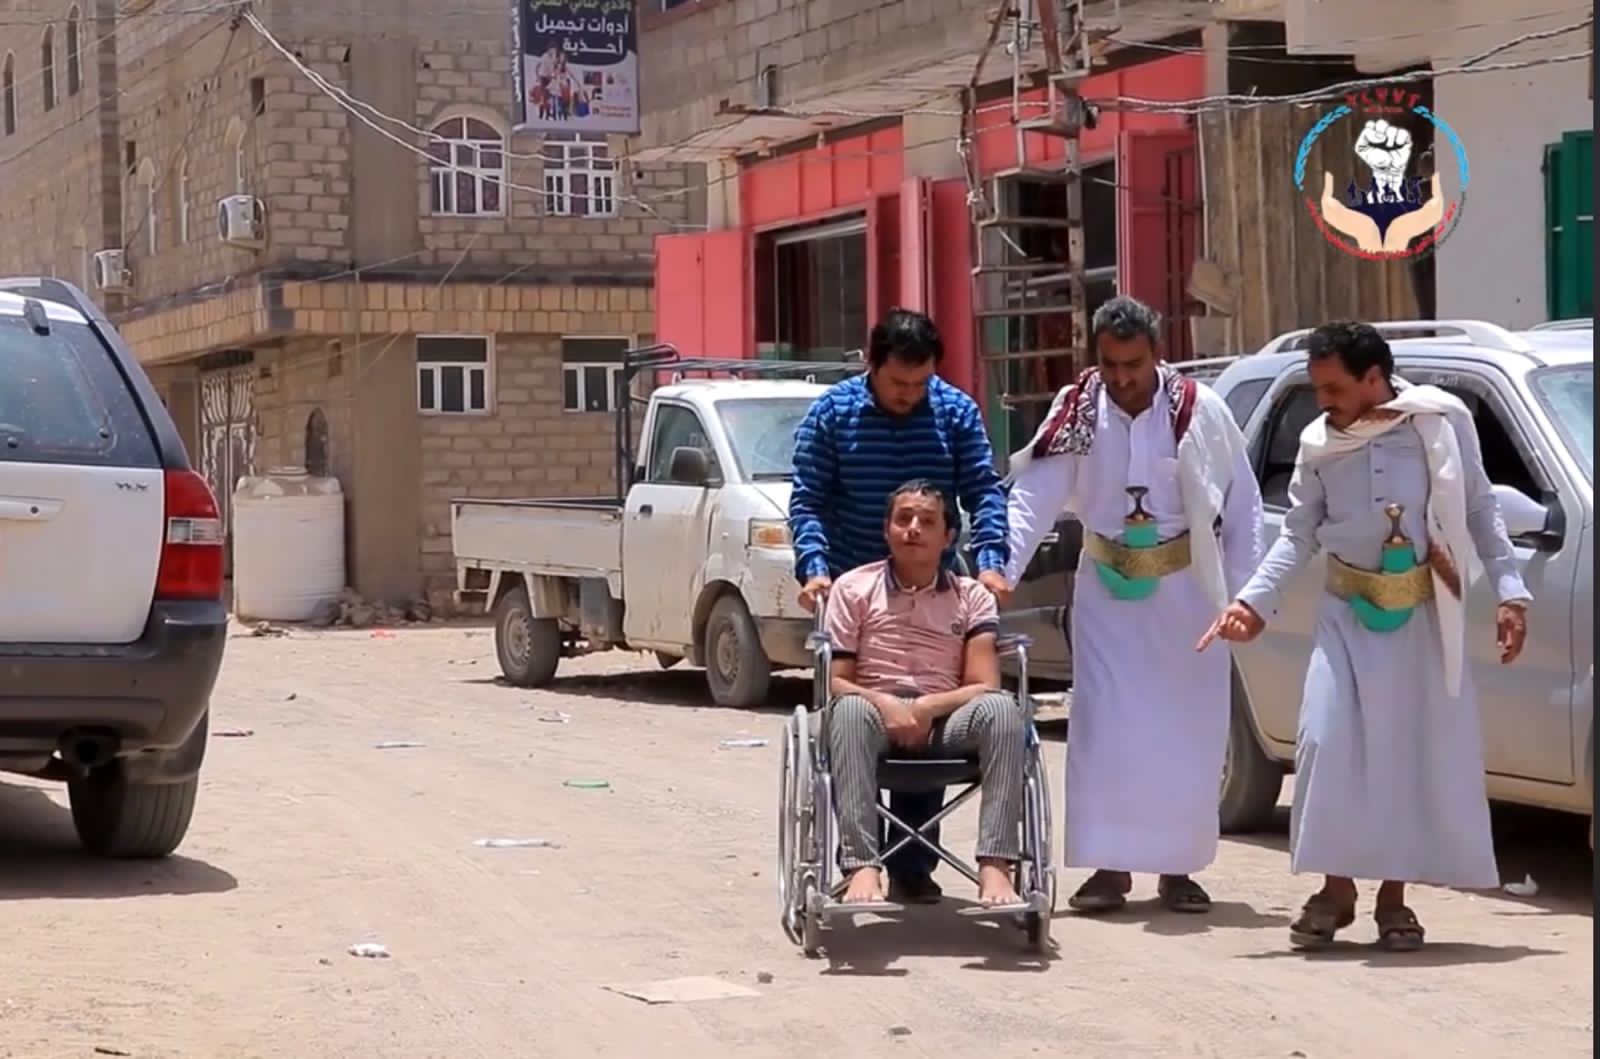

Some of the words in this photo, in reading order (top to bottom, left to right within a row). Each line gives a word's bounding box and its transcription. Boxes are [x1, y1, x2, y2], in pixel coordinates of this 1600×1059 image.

[535, 13, 585, 35] تجميل
[587, 13, 629, 36] أدوات
[562, 34, 623, 56] أحذية
